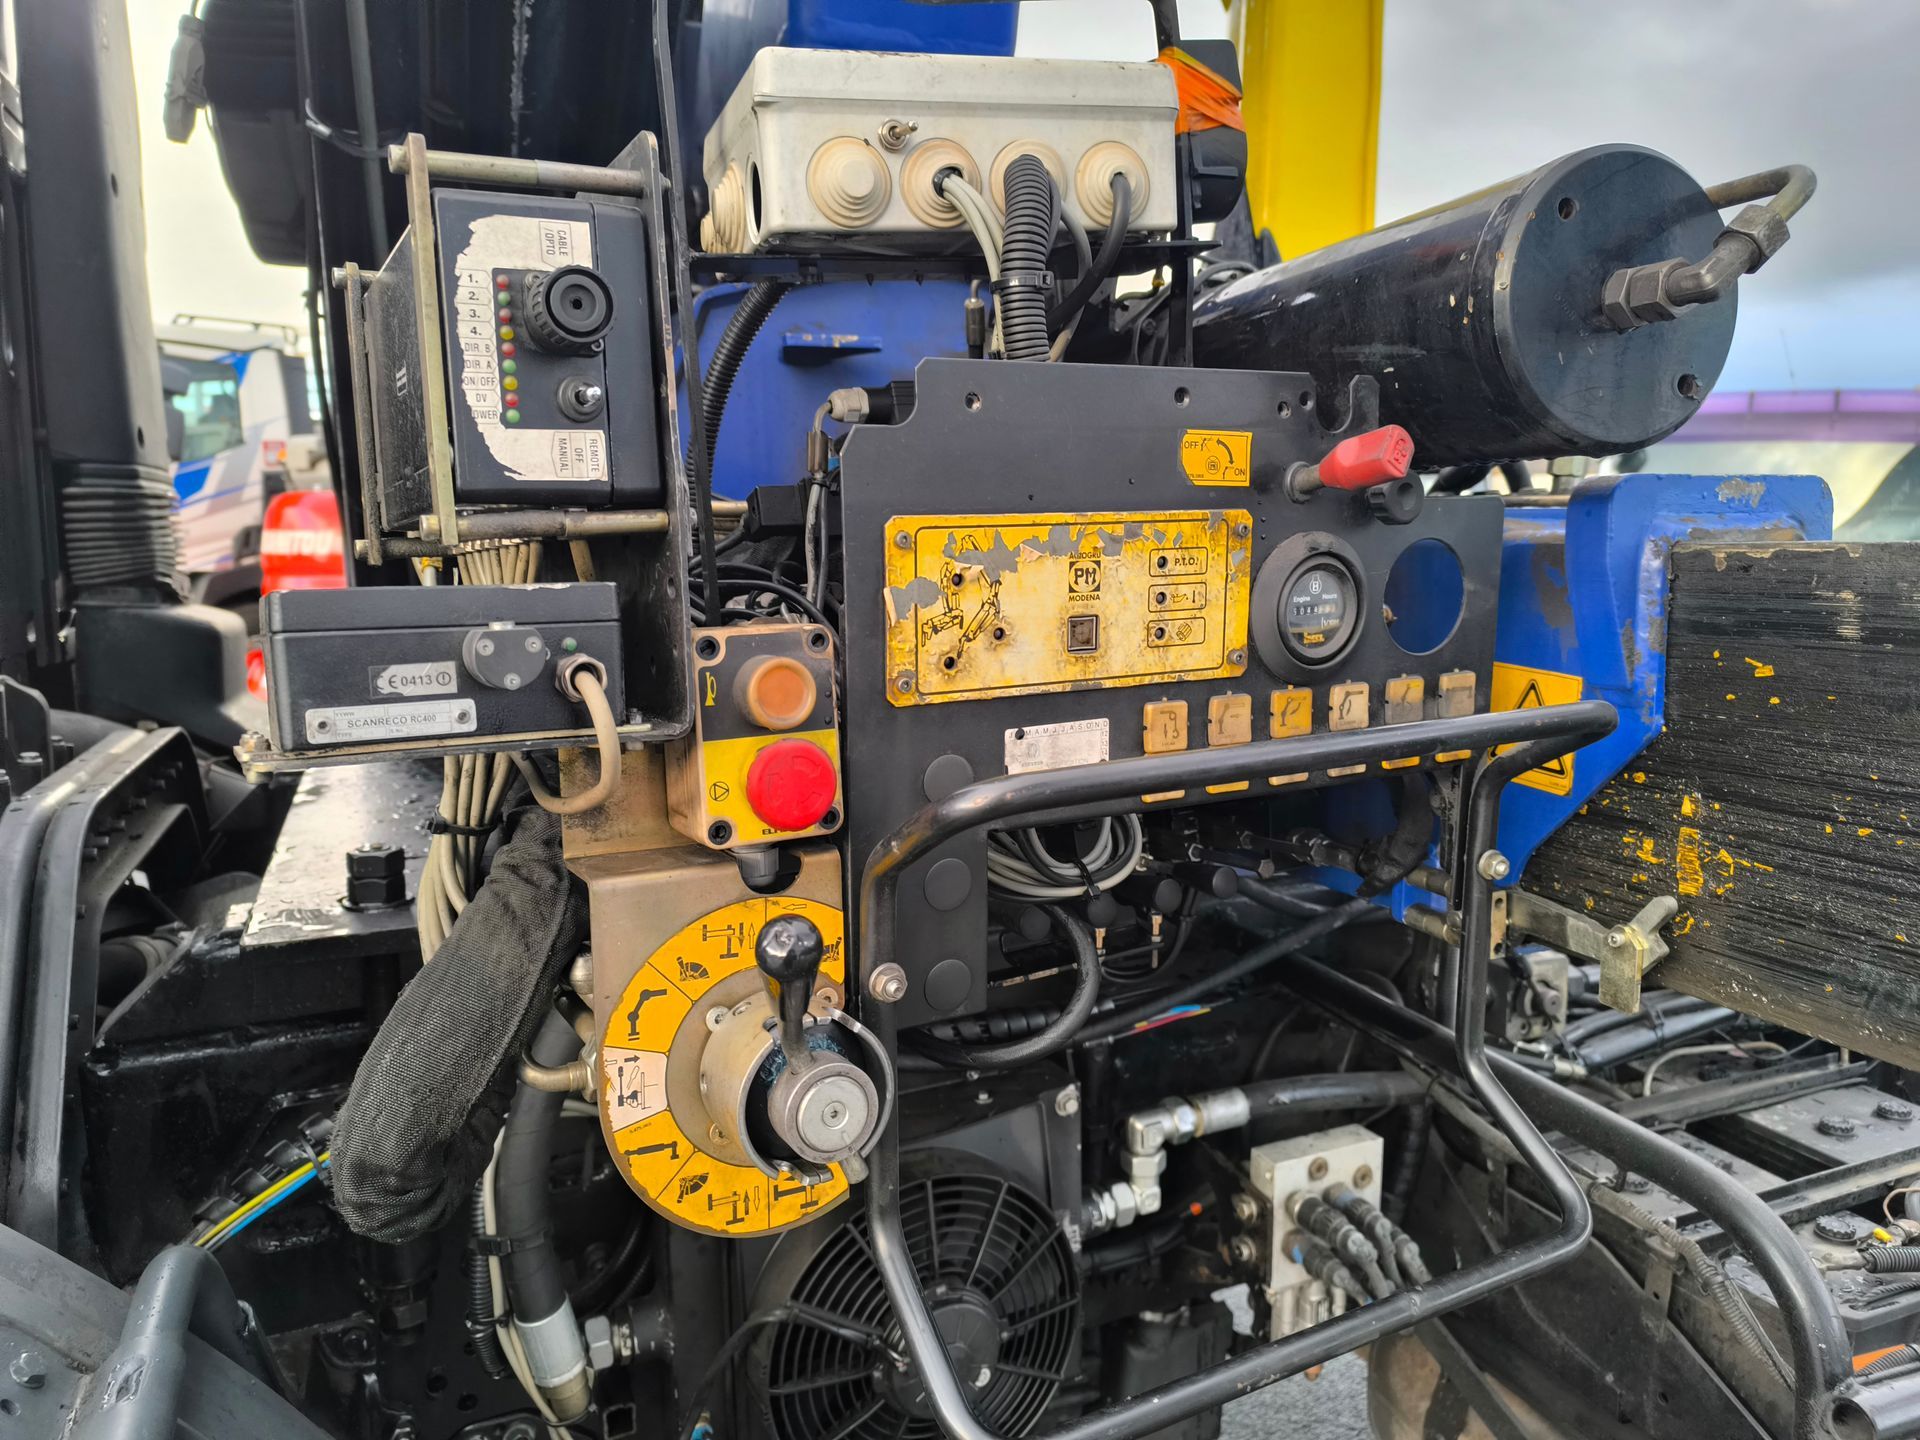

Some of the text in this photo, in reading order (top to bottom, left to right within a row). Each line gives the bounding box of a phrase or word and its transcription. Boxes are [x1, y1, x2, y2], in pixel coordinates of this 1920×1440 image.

[543, 227, 556, 256] /OPTO
[556, 230, 568, 257] CABLE
[467, 274, 479, 283] 1.
[468, 291, 480, 301] 2.
[469, 309, 481, 319] 3.
[470, 326, 482, 336] 4.
[464, 342, 491, 353] DIR B
[465, 360, 493, 370] DIR A
[464, 376, 497, 386] ON/OFF
[472, 409, 499, 420] OWER
[1184, 441, 1199, 449] OFF
[558, 438, 569, 473] MANUAL
[573, 448, 584, 464] OFF
[589, 438, 600, 473] REMOTE
[1234, 467, 1246, 476] ON
[1174, 557, 1199, 567] P.T.O.
[1074, 568, 1097, 585] PM
[1068, 593, 1101, 603] MODENA
[400, 674, 433, 687] 0413
[347, 714, 438, 728] SCANRECO RC400
